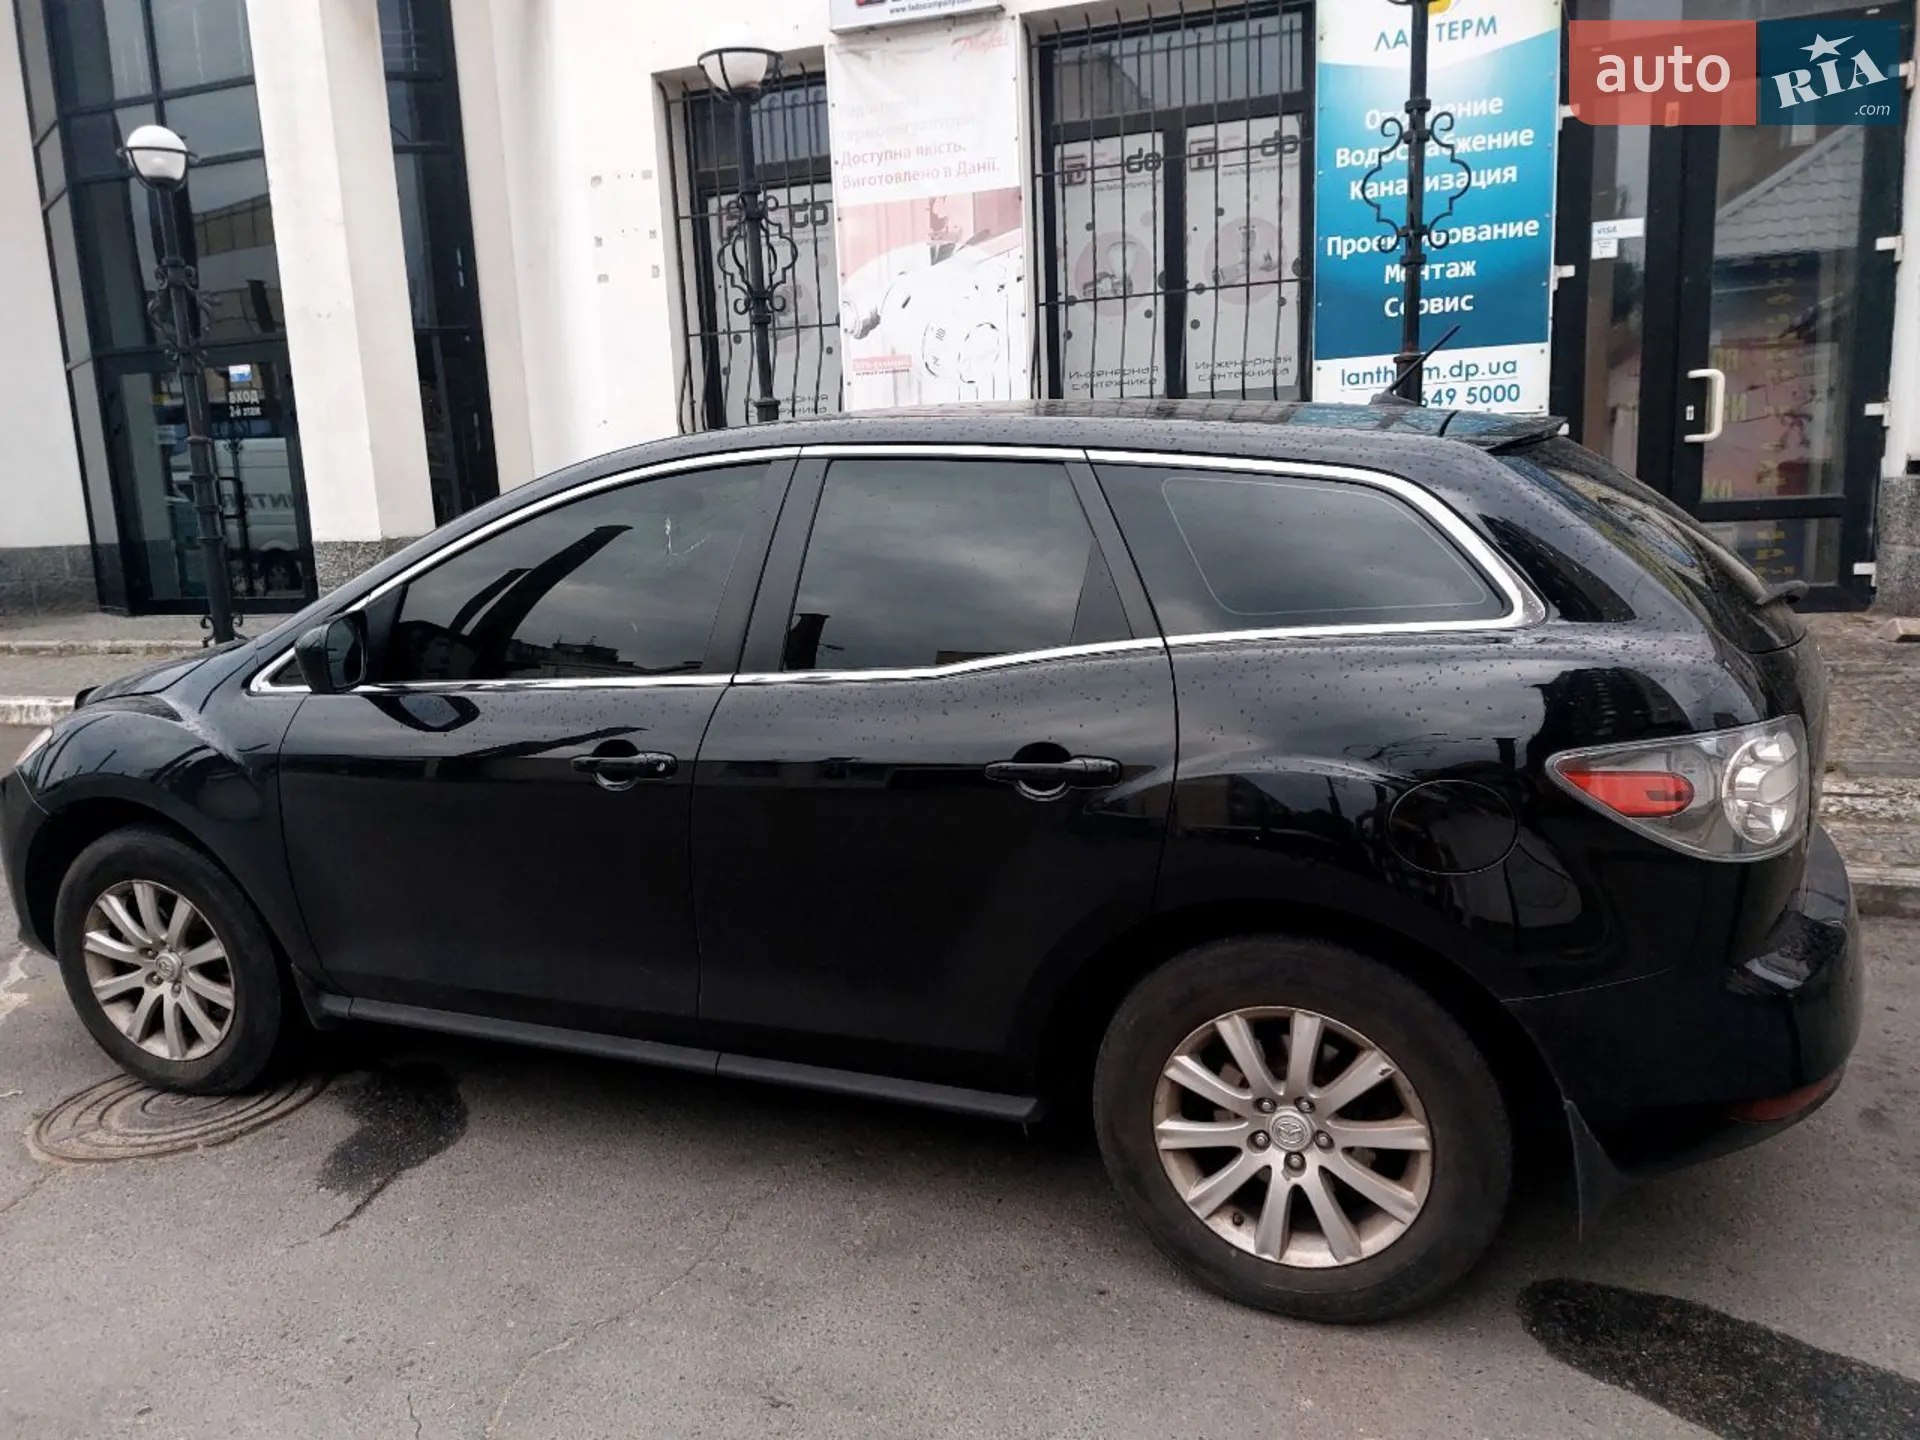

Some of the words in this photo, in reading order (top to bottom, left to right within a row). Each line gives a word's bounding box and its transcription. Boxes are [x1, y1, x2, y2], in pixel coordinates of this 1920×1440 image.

[840, 146, 912, 168] Доступна
[1335, 128, 1535, 168] Водосабжение
[842, 167, 940, 189] Виготовлено
[943, 167, 952, 178] в
[1350, 165, 1518, 200] Канаизация
[1326, 219, 1540, 260] Проекирование
[1341, 360, 1518, 386] lanthm.dp.ua
[228, 389, 260, 404] ВХОД
[1466, 384, 1521, 404] 5000
